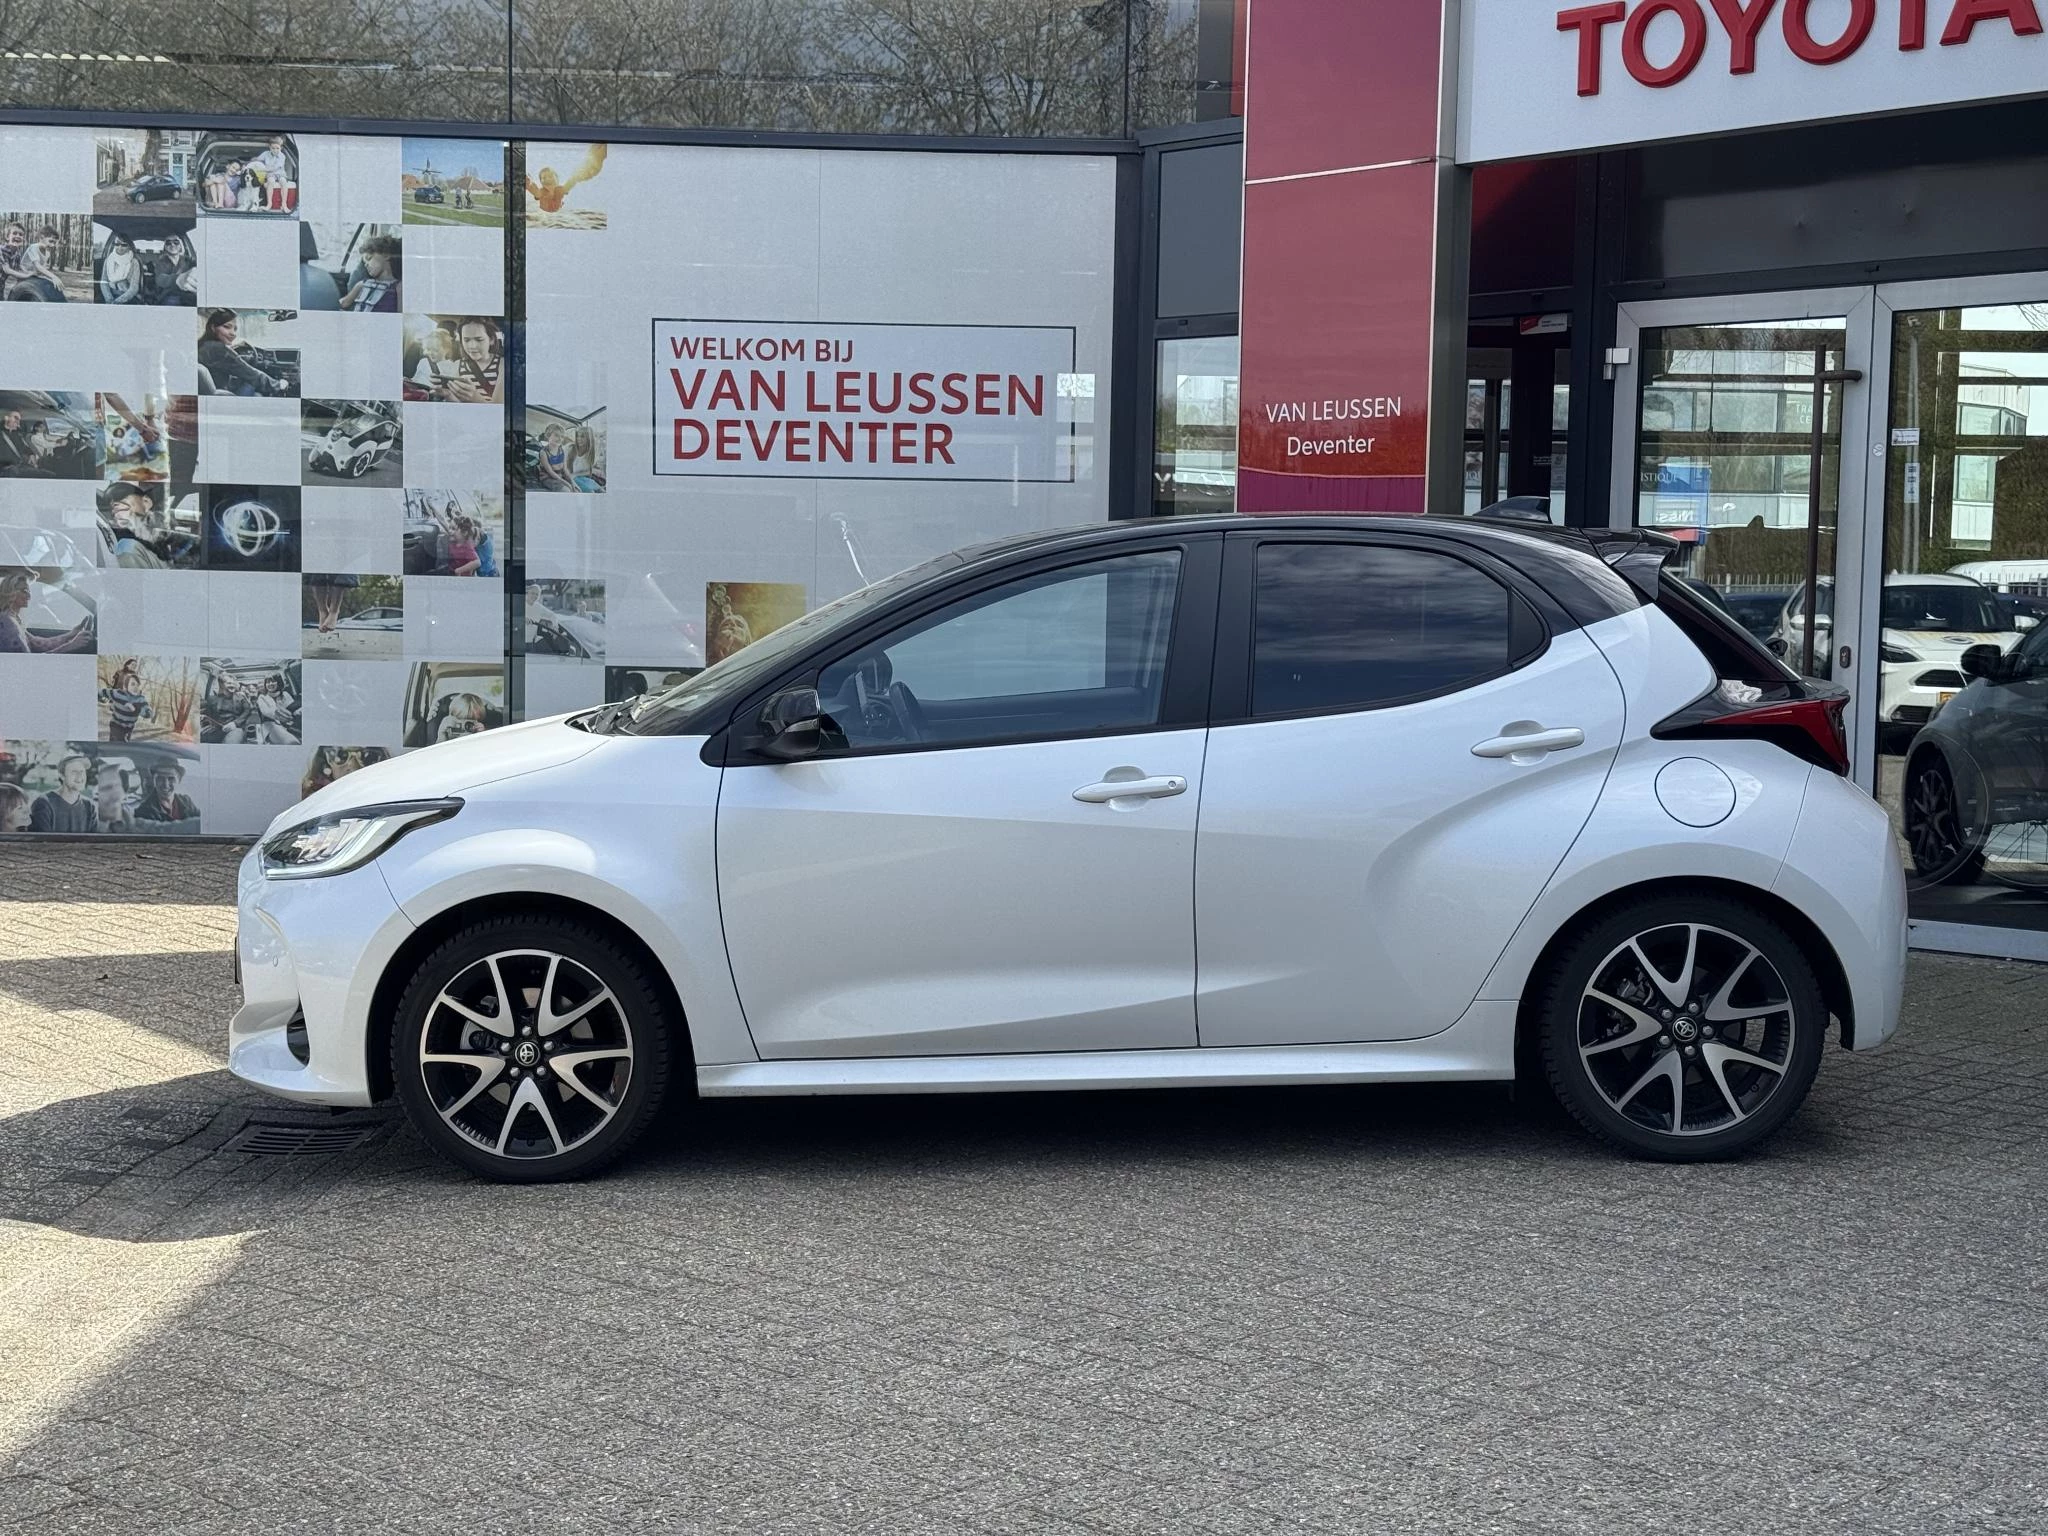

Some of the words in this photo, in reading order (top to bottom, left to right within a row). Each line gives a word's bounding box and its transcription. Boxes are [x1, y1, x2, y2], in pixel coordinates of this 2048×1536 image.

[670, 336, 805, 362] WELKOM
[815, 338, 854, 363] BIJ
[670, 368, 786, 412] VAN
[806, 371, 1044, 416] LEUSSEN
[1265, 402, 1306, 423] VAN
[1312, 396, 1401, 421] LEUSSEN
[673, 418, 956, 465] DEVENTER
[1287, 435, 1376, 456] Deventer
